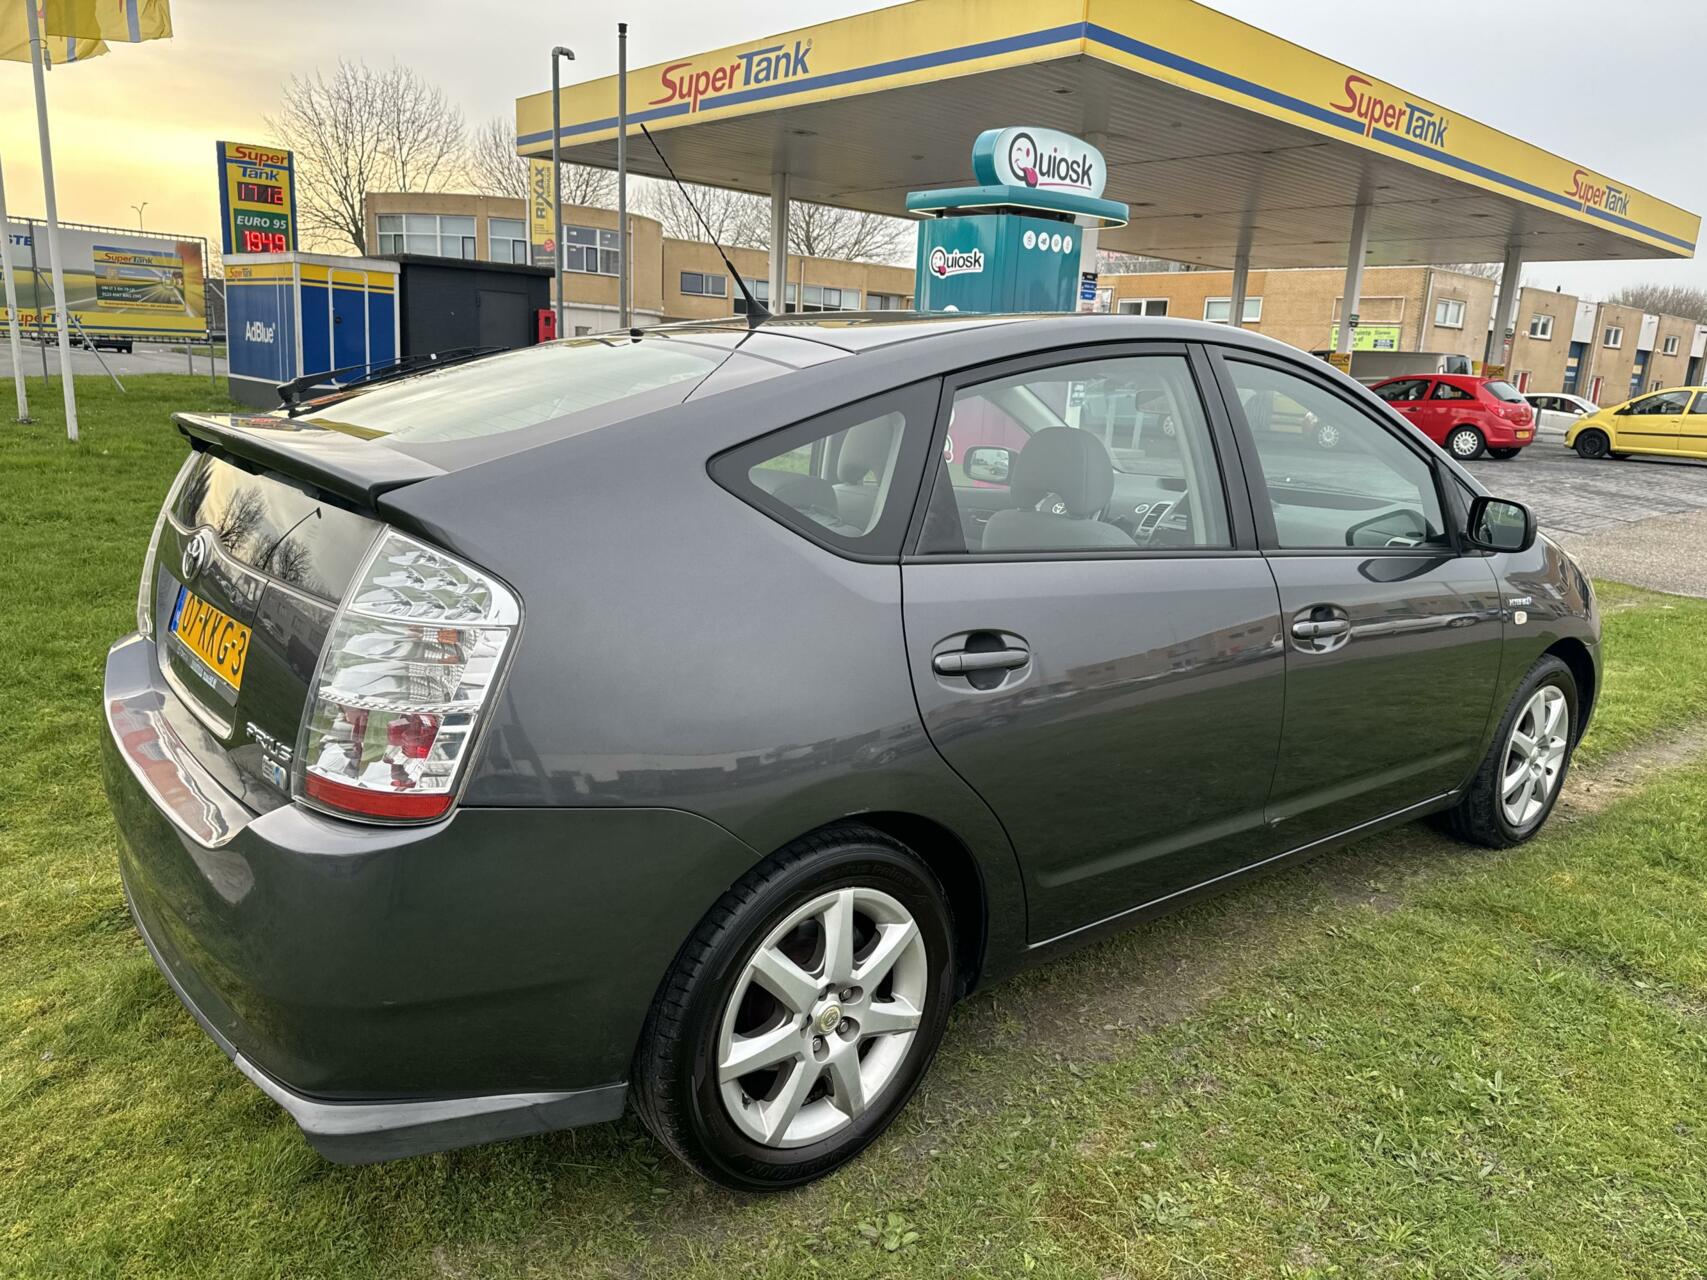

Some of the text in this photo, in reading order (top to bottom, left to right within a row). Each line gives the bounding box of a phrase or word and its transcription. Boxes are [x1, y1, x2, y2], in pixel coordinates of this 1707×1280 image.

[648, 41, 812, 113] SuperTank
[1329, 75, 1448, 148] SuperTank
[226, 145, 287, 168] Super
[237, 165, 280, 182] Tank
[1008, 132, 1093, 188] Quiosk
[533, 166, 553, 220] RIXAX
[1563, 169, 1630, 216] SuperTank
[236, 216, 287, 229] EURO 95
[103, 252, 153, 265] SuperTank
[931, 249, 982, 276] Quiosk
[245, 320, 275, 343] AdBlue
[182, 594, 247, 676] 07-KKG-3
[246, 721, 292, 761] PRIUS
